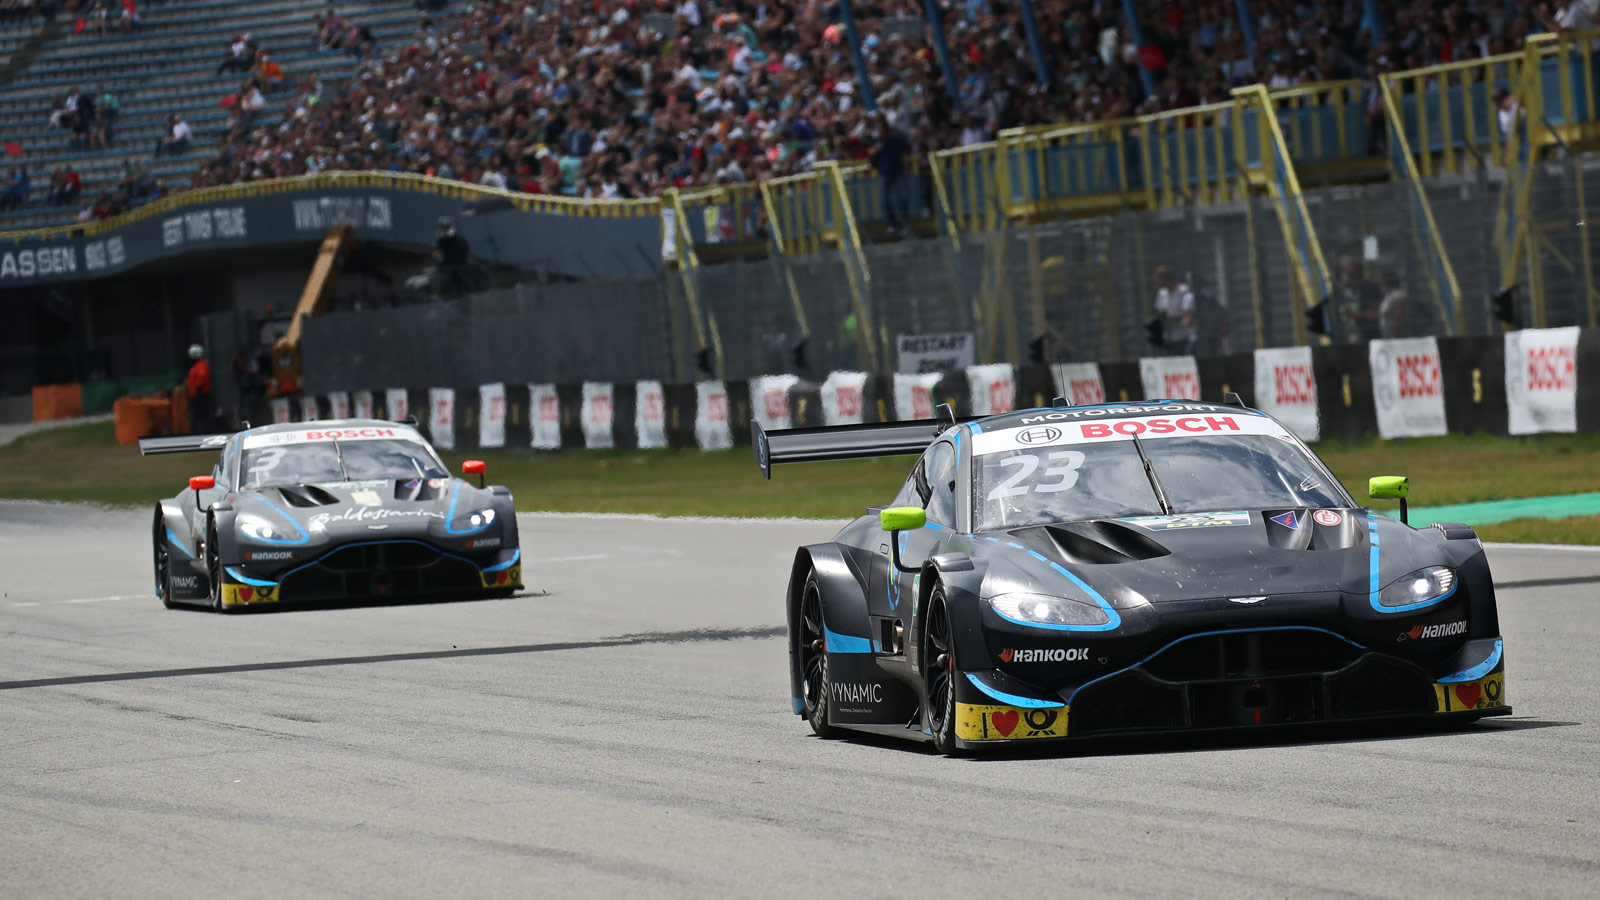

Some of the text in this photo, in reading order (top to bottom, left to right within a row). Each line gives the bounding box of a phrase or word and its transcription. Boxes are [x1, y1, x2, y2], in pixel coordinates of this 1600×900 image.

[1, 245, 76, 277] ASSEN
[902, 335, 965, 353] RESTART
[1396, 353, 1443, 398] BOSCH
[1528, 347, 1577, 391] BOSCH
[1274, 365, 1318, 404] BOSCH
[1021, 405, 1219, 424] MOTORSPORT
[307, 429, 394, 440] BOSCH
[1080, 417, 1241, 438] BOSCH
[249, 447, 287, 473] 3
[987, 451, 1085, 500] 23
[309, 507, 445, 524] Baldessarini
[831, 682, 882, 702] VYNAMIC
